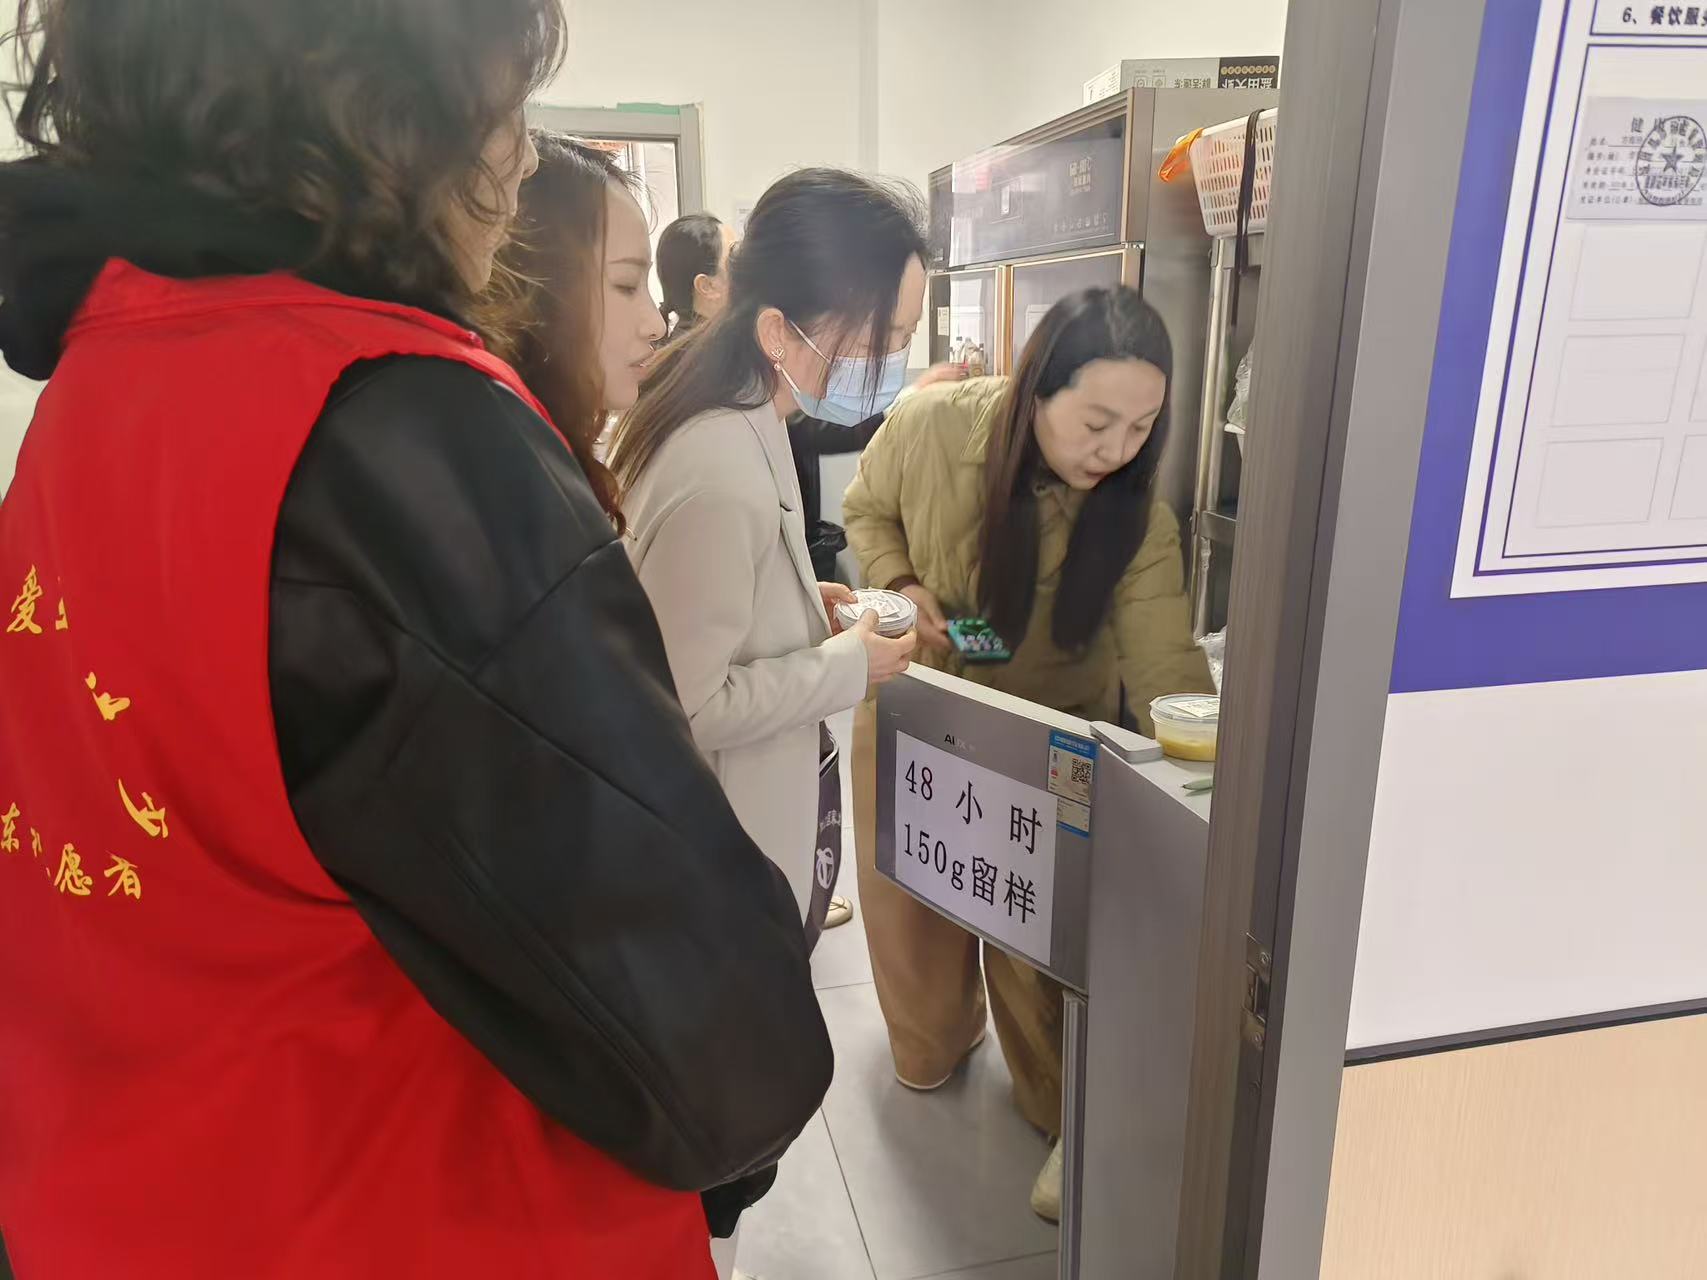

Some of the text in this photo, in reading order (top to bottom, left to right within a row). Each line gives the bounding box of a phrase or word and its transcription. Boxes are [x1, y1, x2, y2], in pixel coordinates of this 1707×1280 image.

[904, 759, 934, 802] 48
[955, 780, 984, 826] 小
[1008, 803, 1043, 855] 时
[903, 822, 1037, 925] 150g留样
